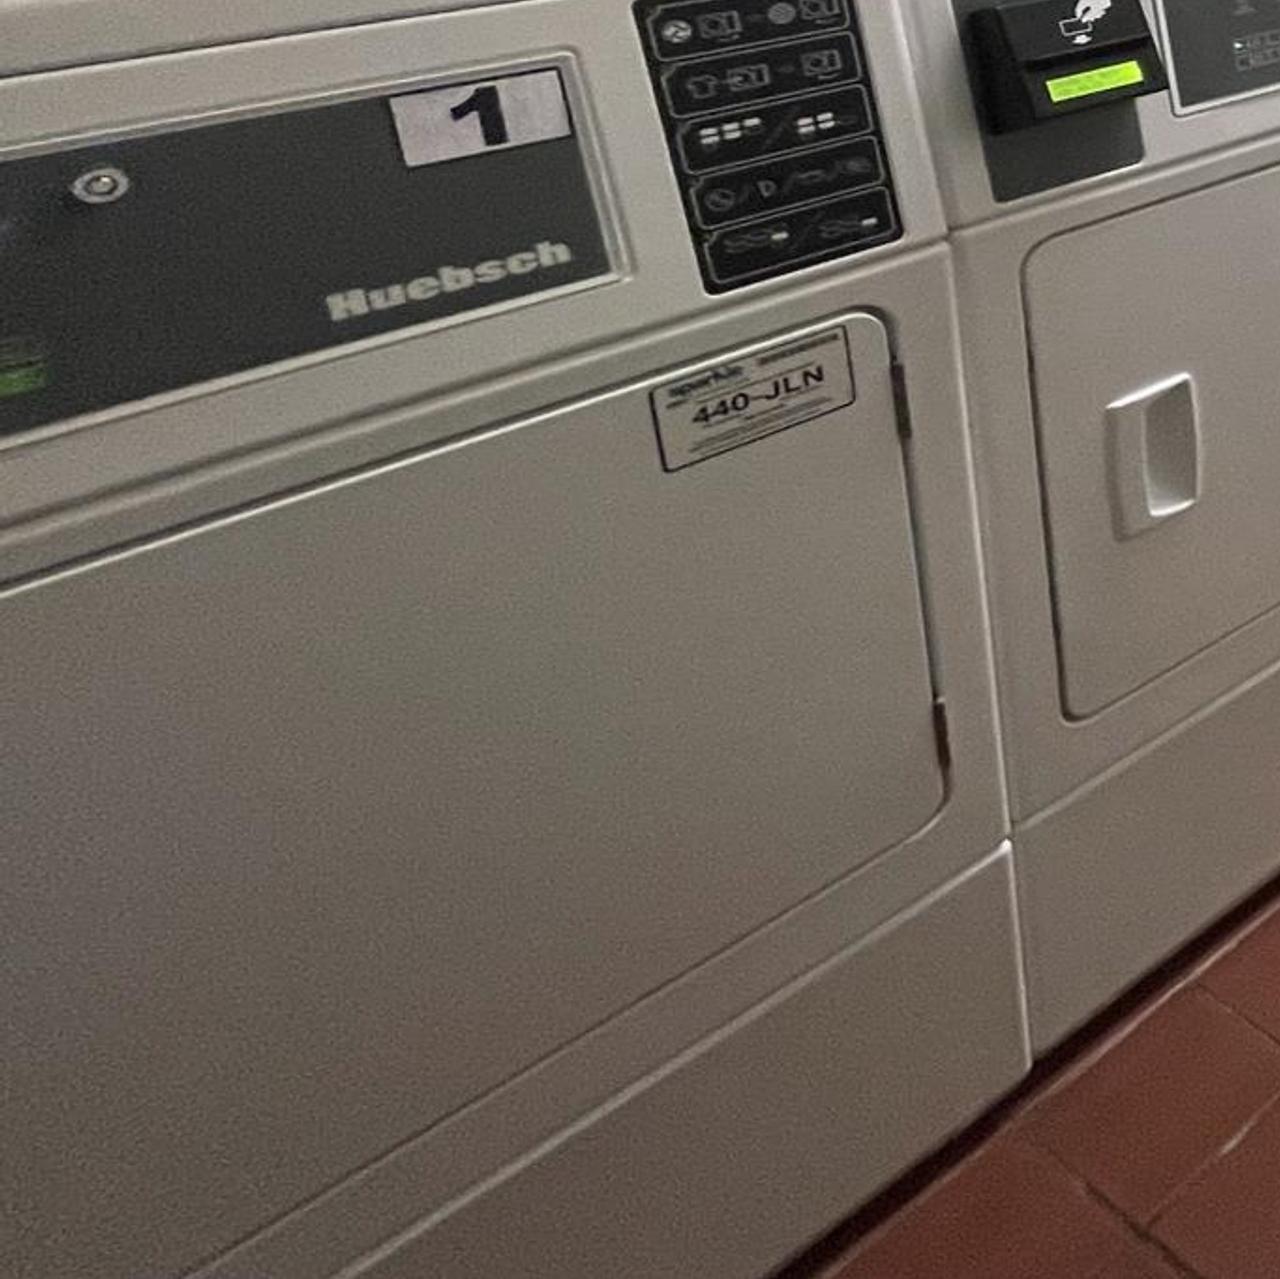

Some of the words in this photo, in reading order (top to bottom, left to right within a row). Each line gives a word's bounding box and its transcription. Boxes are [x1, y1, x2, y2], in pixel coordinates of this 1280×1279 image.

[450, 85, 509, 146] 1
[326, 241, 572, 322] Huebsch
[692, 365, 824, 424] 440-JLN
